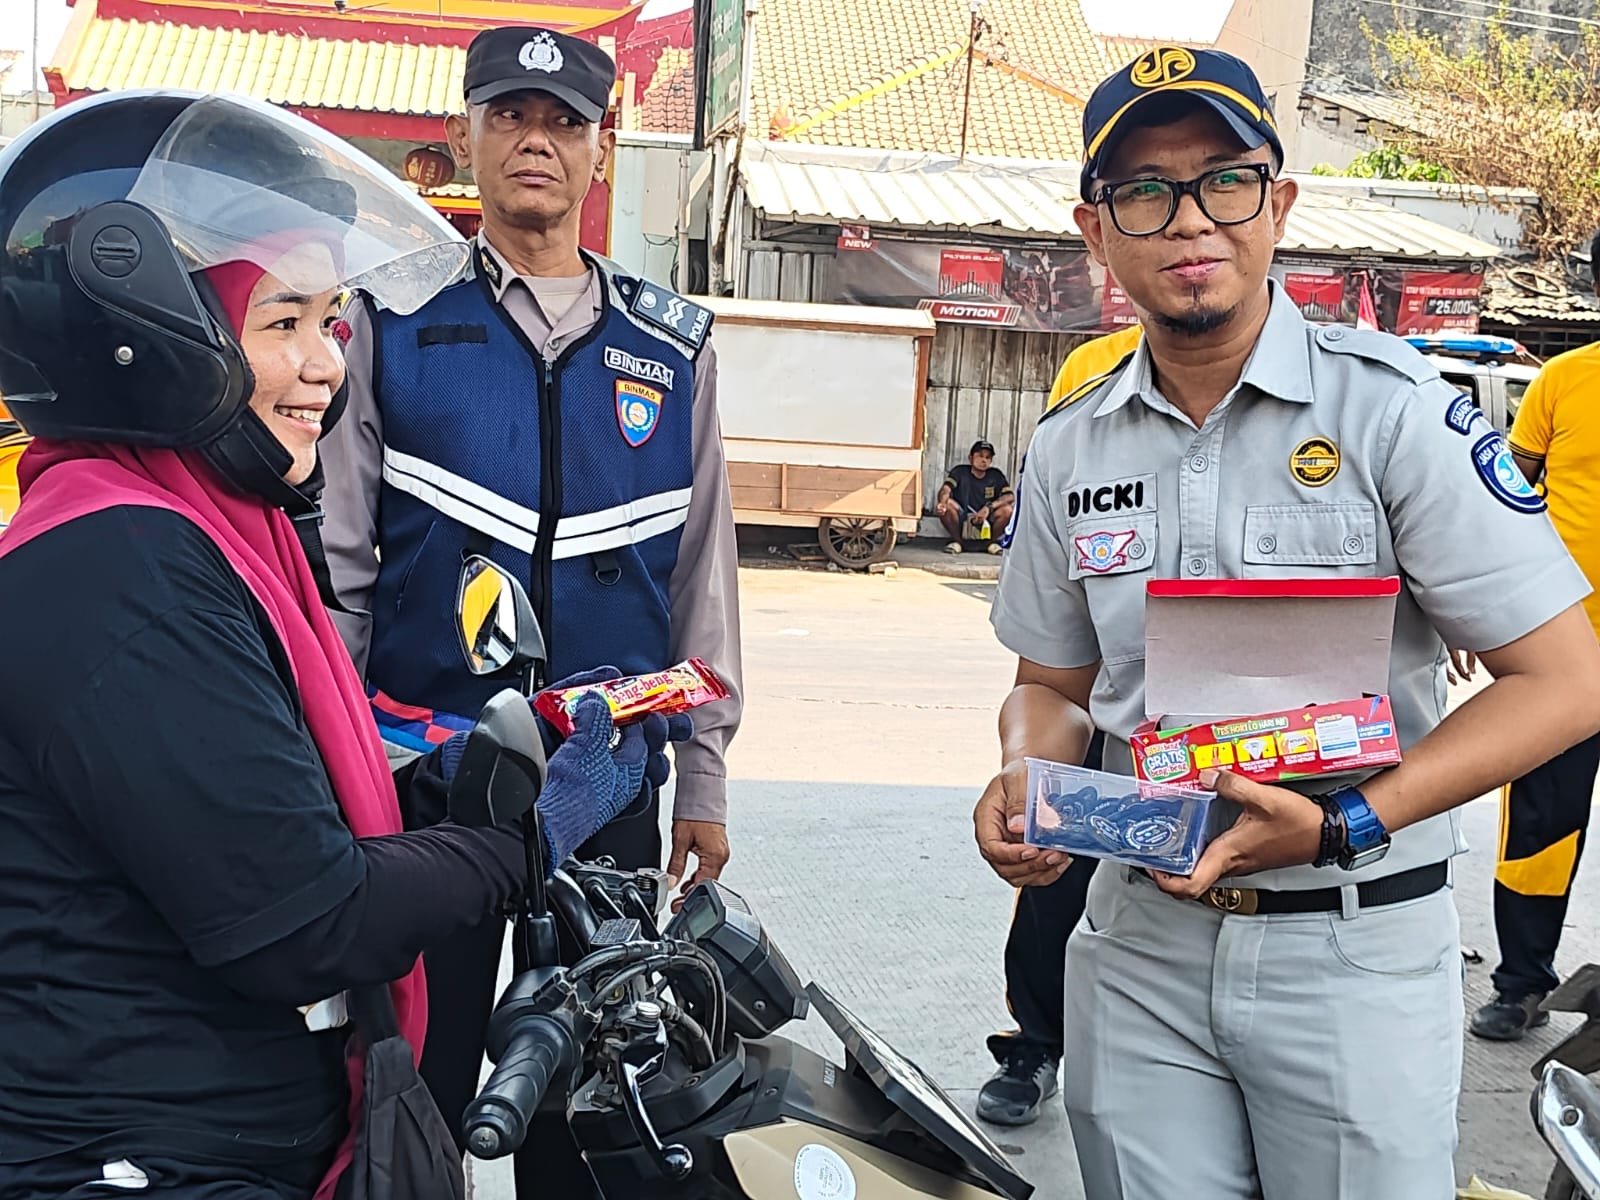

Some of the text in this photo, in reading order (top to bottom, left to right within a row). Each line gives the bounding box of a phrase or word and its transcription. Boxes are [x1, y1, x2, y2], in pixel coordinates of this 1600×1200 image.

[844, 239, 873, 249] NEW
[939, 305, 999, 318] MOTION
[688, 308, 710, 342] POLISI
[609, 351, 669, 383] BINMAS
[624, 383, 656, 400] BINMAS
[1067, 480, 1144, 518] DICKI
[1146, 749, 1186, 772] GRATIS
